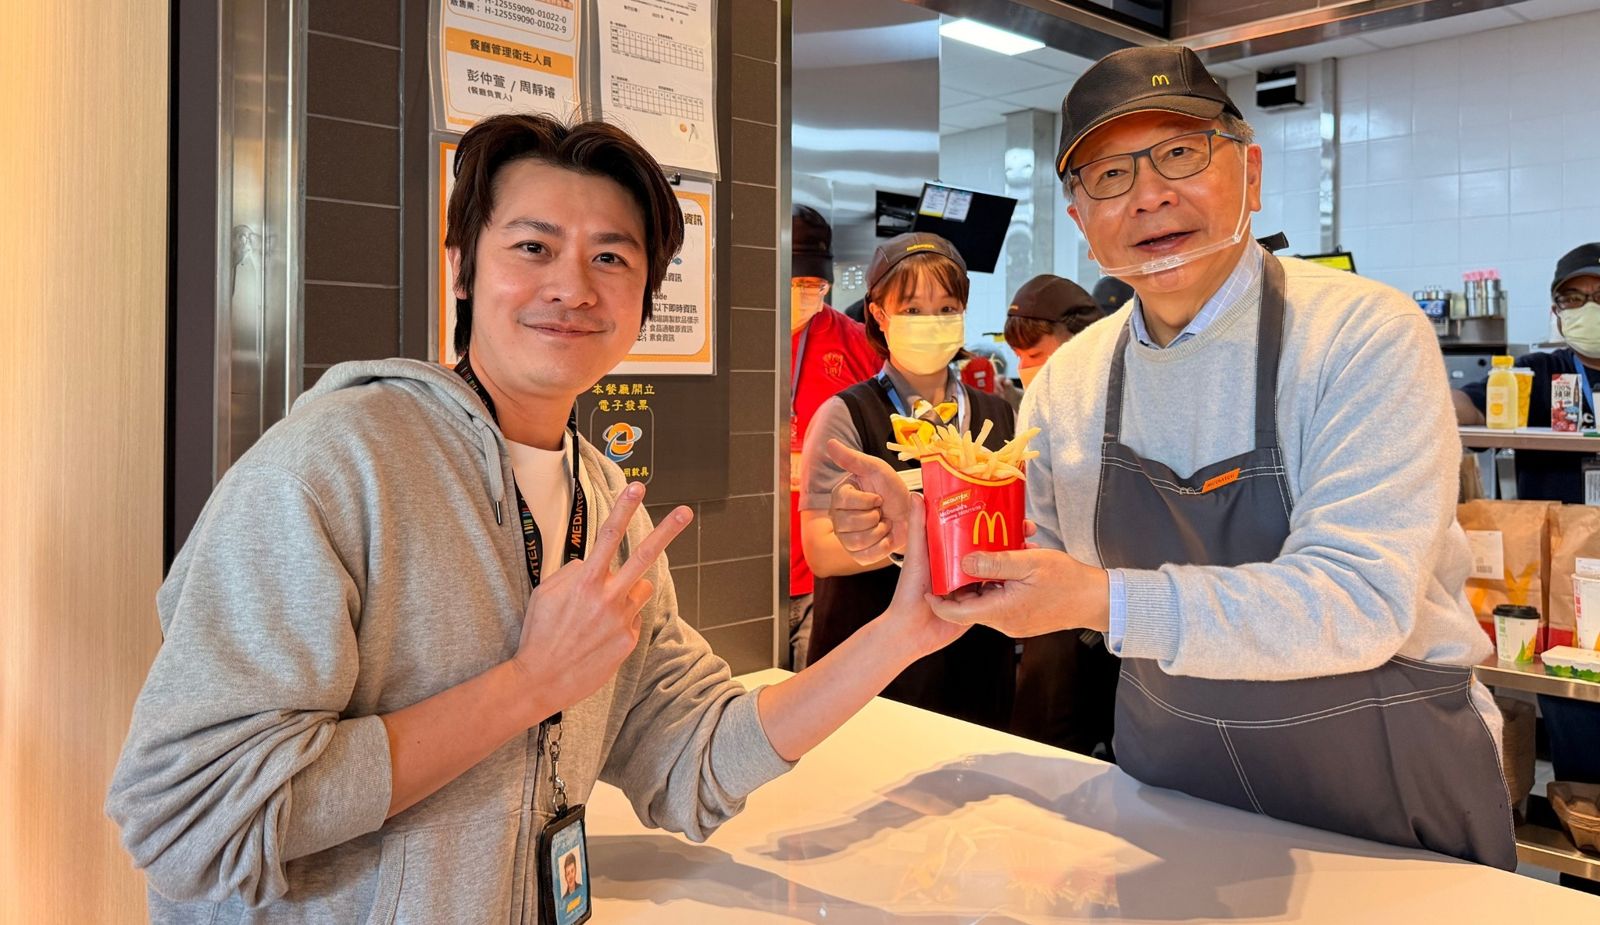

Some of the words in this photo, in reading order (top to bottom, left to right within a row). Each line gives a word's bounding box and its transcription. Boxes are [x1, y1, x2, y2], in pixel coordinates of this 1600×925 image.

[485, 7, 567, 33] H-125559090-01022-9
[469, 39, 552, 67] 餐廳管理衛生人員
[467, 69, 505, 88] 彭仲萱
[684, 213, 703, 226] 資訊
[592, 383, 655, 395] 本餐廳開立
[598, 399, 649, 411] 電子發票
